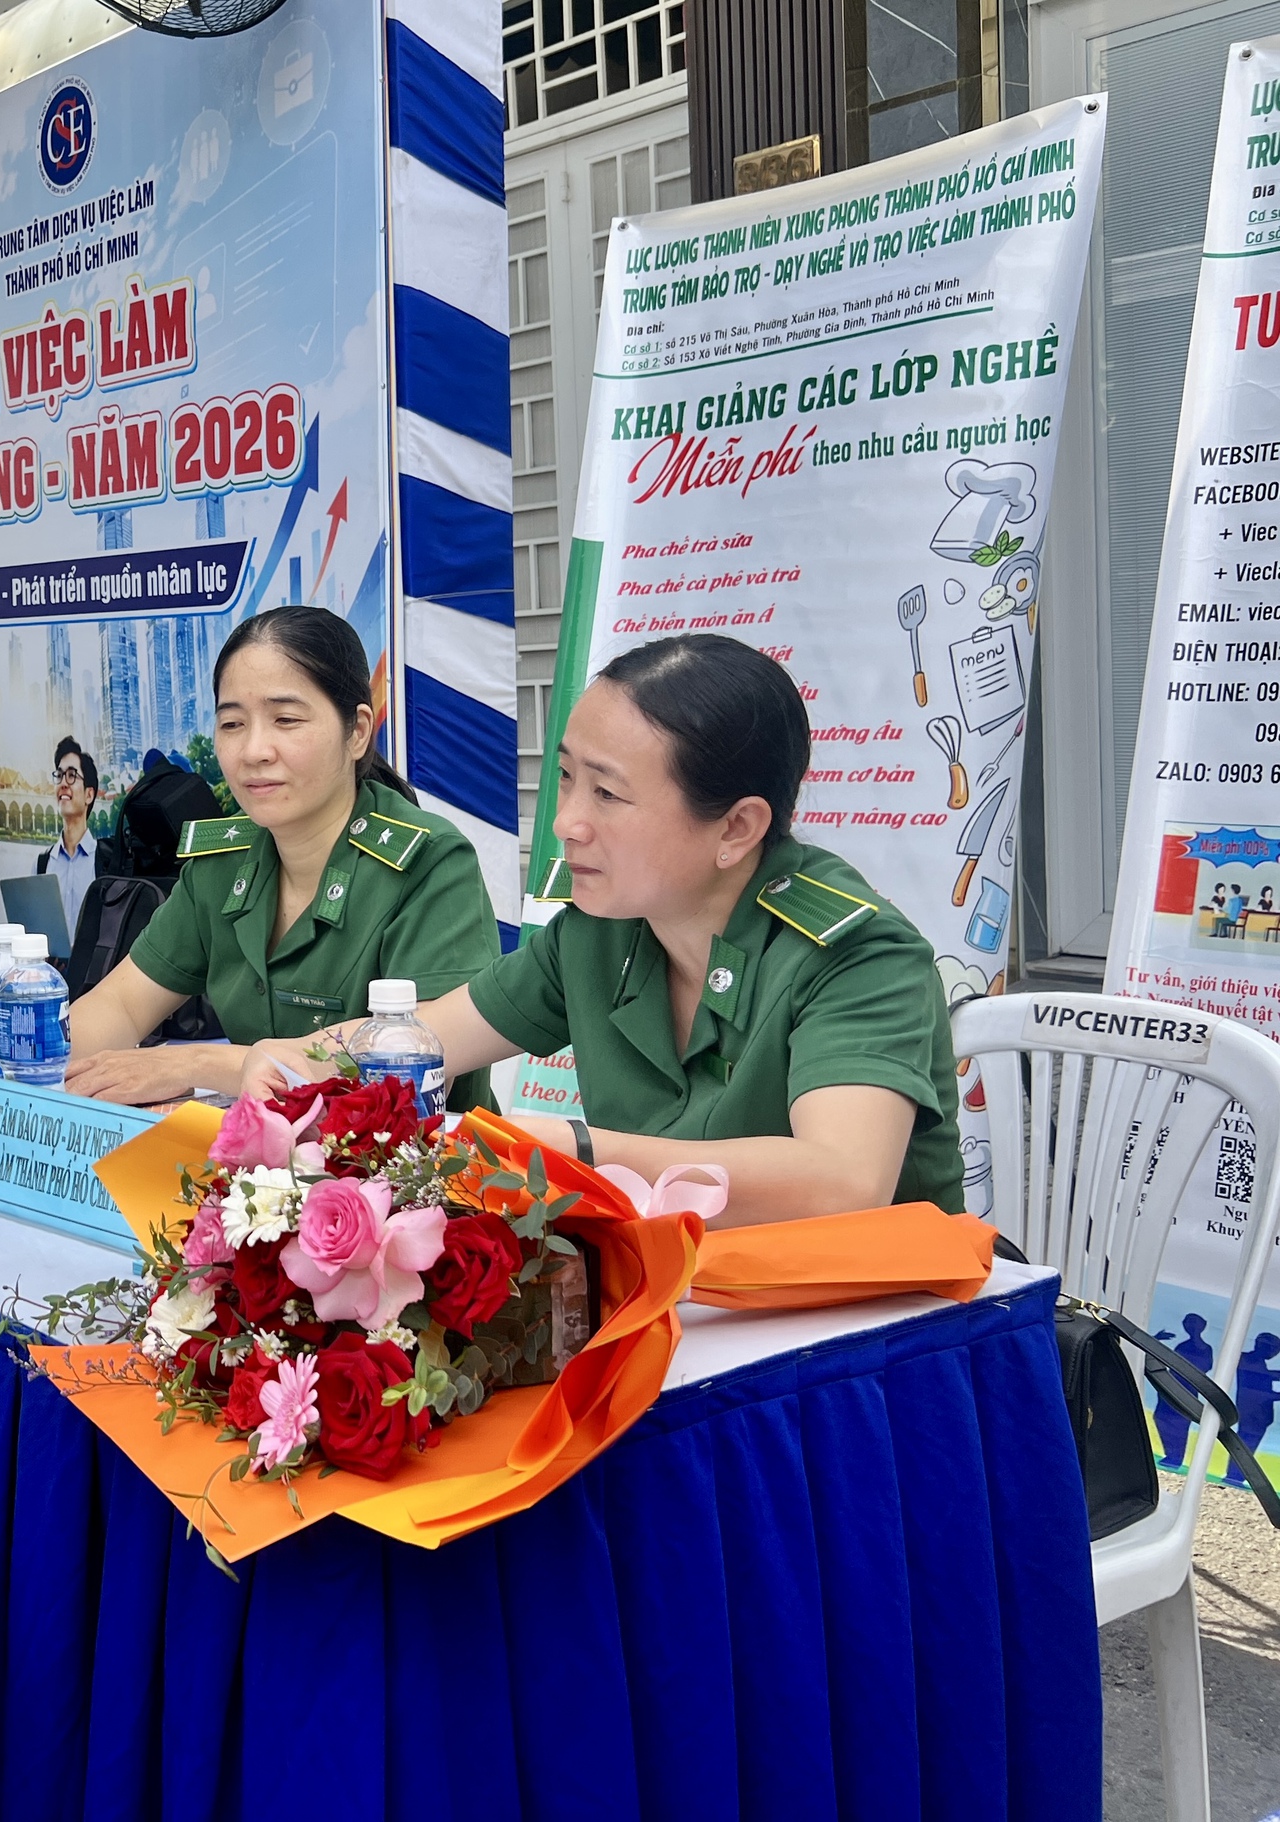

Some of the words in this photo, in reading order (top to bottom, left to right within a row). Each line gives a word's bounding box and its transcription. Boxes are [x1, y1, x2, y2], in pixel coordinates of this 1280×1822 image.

[27, 219, 49, 248] TÂM
[53, 209, 78, 243] DỊCH
[81, 202, 95, 232] VỤ
[99, 190, 124, 224] VIỆC
[128, 181, 153, 213] LÀM
[626, 247, 652, 279] LỰC
[655, 237, 698, 274] LƯỢNG
[704, 226, 746, 260] THANH
[749, 215, 781, 250] NIÊN
[784, 208, 824, 241] XUNG
[827, 194, 879, 232] PHONG
[884, 179, 933, 218] THÀNH
[935, 159, 970, 205] PHỐ
[972, 151, 997, 194] HỒ
[1001, 146, 1028, 185] CHÍ
[1029, 139, 1075, 178] MINH
[623, 284, 666, 314] TRUNG
[671, 275, 698, 307] TÂM
[702, 265, 729, 300] BẢO
[734, 263, 761, 297] TRỢ
[773, 255, 804, 290] DẠY
[807, 234, 845, 278] NGHỀ
[849, 233, 867, 268] VÀ
[873, 231, 902, 267] TẠO
[908, 217, 940, 258] VIỆC
[941, 209, 976, 245] LÀM
[981, 195, 1033, 235] THÀNH
[1038, 176, 1076, 224] PHỐ
[6, 265, 39, 297] THÀNH
[42, 248, 63, 286] PHỐ
[66, 242, 81, 277] HỒ
[85, 237, 103, 271] CHÍ
[107, 231, 138, 264] MINH
[679, 335, 696, 347] 215
[715, 329, 727, 341] Thị
[754, 318, 788, 332] Phường
[792, 311, 815, 324] Xuân
[843, 299, 871, 313] Thành
[875, 291, 893, 308] phố
[897, 286, 910, 300] Hồ
[914, 283, 931, 296] Chí
[934, 277, 960, 292] Minh
[3, 308, 86, 407] VIỆC
[100, 283, 188, 377] LÀM
[611, 401, 686, 440] KHAI
[696, 382, 787, 431] GIẢNG
[797, 366, 858, 412] CÁC
[870, 349, 938, 400] LỚP
[951, 323, 1058, 388] NGHỀ
[72, 413, 158, 500] NĂM
[174, 393, 295, 484] 2026
[627, 432, 745, 504] Miễn
[741, 424, 817, 499] phí
[813, 440, 851, 467] theo
[858, 432, 894, 460] nhu
[902, 423, 938, 452] cầu
[947, 417, 1006, 454] người
[1015, 413, 1050, 445] học
[622, 545, 657, 559] Pha
[660, 536, 689, 556] chế
[691, 536, 718, 553] trà
[721, 532, 753, 550] sữa
[12, 575, 45, 606] Phát
[49, 566, 85, 604] triển
[91, 563, 142, 604] nguồn
[147, 562, 191, 596] nhân
[197, 561, 227, 600] lực
[613, 614, 647, 633] Chế
[648, 612, 686, 631] biến
[689, 611, 727, 628] món
[731, 609, 755, 625] ăn
[758, 603, 775, 623] Á
[1178, 604, 1240, 622] EMAIL:
[962, 644, 1004, 668] menu
[1173, 640, 1217, 665] ĐIỆN
[1167, 682, 1249, 701] HOTLINE:
[873, 720, 903, 741] Âu
[848, 768, 873, 783] cơ
[874, 764, 915, 783] bản
[1156, 761, 1211, 782] ZALO:
[1218, 763, 1262, 784] 0903
[802, 812, 847, 828] may
[851, 808, 906, 829] nâng
[910, 813, 947, 826] cao
[1126, 967, 1150, 983] Tư
[1154, 968, 1186, 990] vấn,
[1190, 971, 1217, 992] giới
[1222, 978, 1258, 998] thiệu
[1032, 1004, 1209, 1044] VIPCENTER33
[1253, 1005, 1273, 1025] tật
[522, 1082, 567, 1102] theo
[19, 1103, 40, 1142] BẢO
[37, 1116, 63, 1155] TRỢ
[67, 1122, 92, 1161] DẠY
